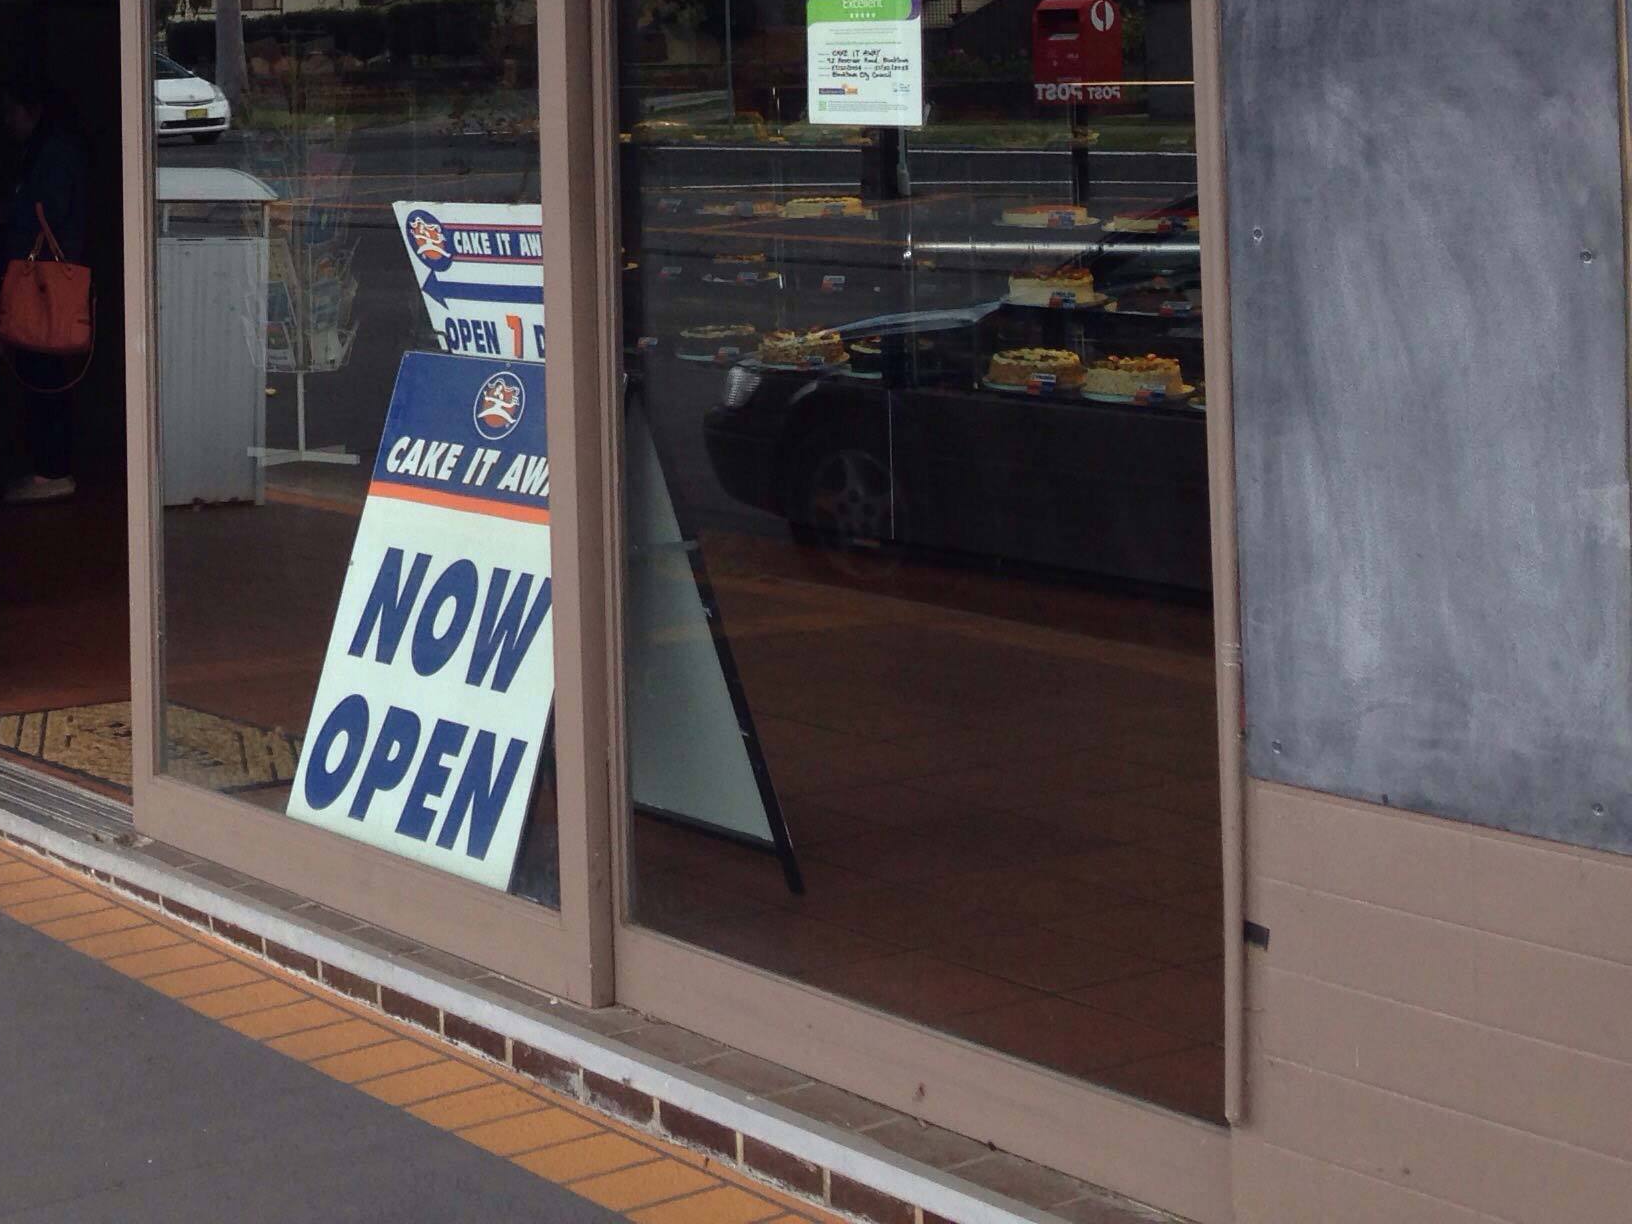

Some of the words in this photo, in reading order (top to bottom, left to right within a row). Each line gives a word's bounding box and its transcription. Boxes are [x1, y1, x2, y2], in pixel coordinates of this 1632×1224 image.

[453, 230, 492, 256] CAKE
[496, 232, 512, 256] IT
[445, 316, 501, 355] OPEN
[505, 314, 524, 359] 7
[386, 436, 465, 481] CAKE
[462, 447, 502, 487] IT
[348, 546, 552, 695] NOW
[303, 693, 529, 863] OPEN
